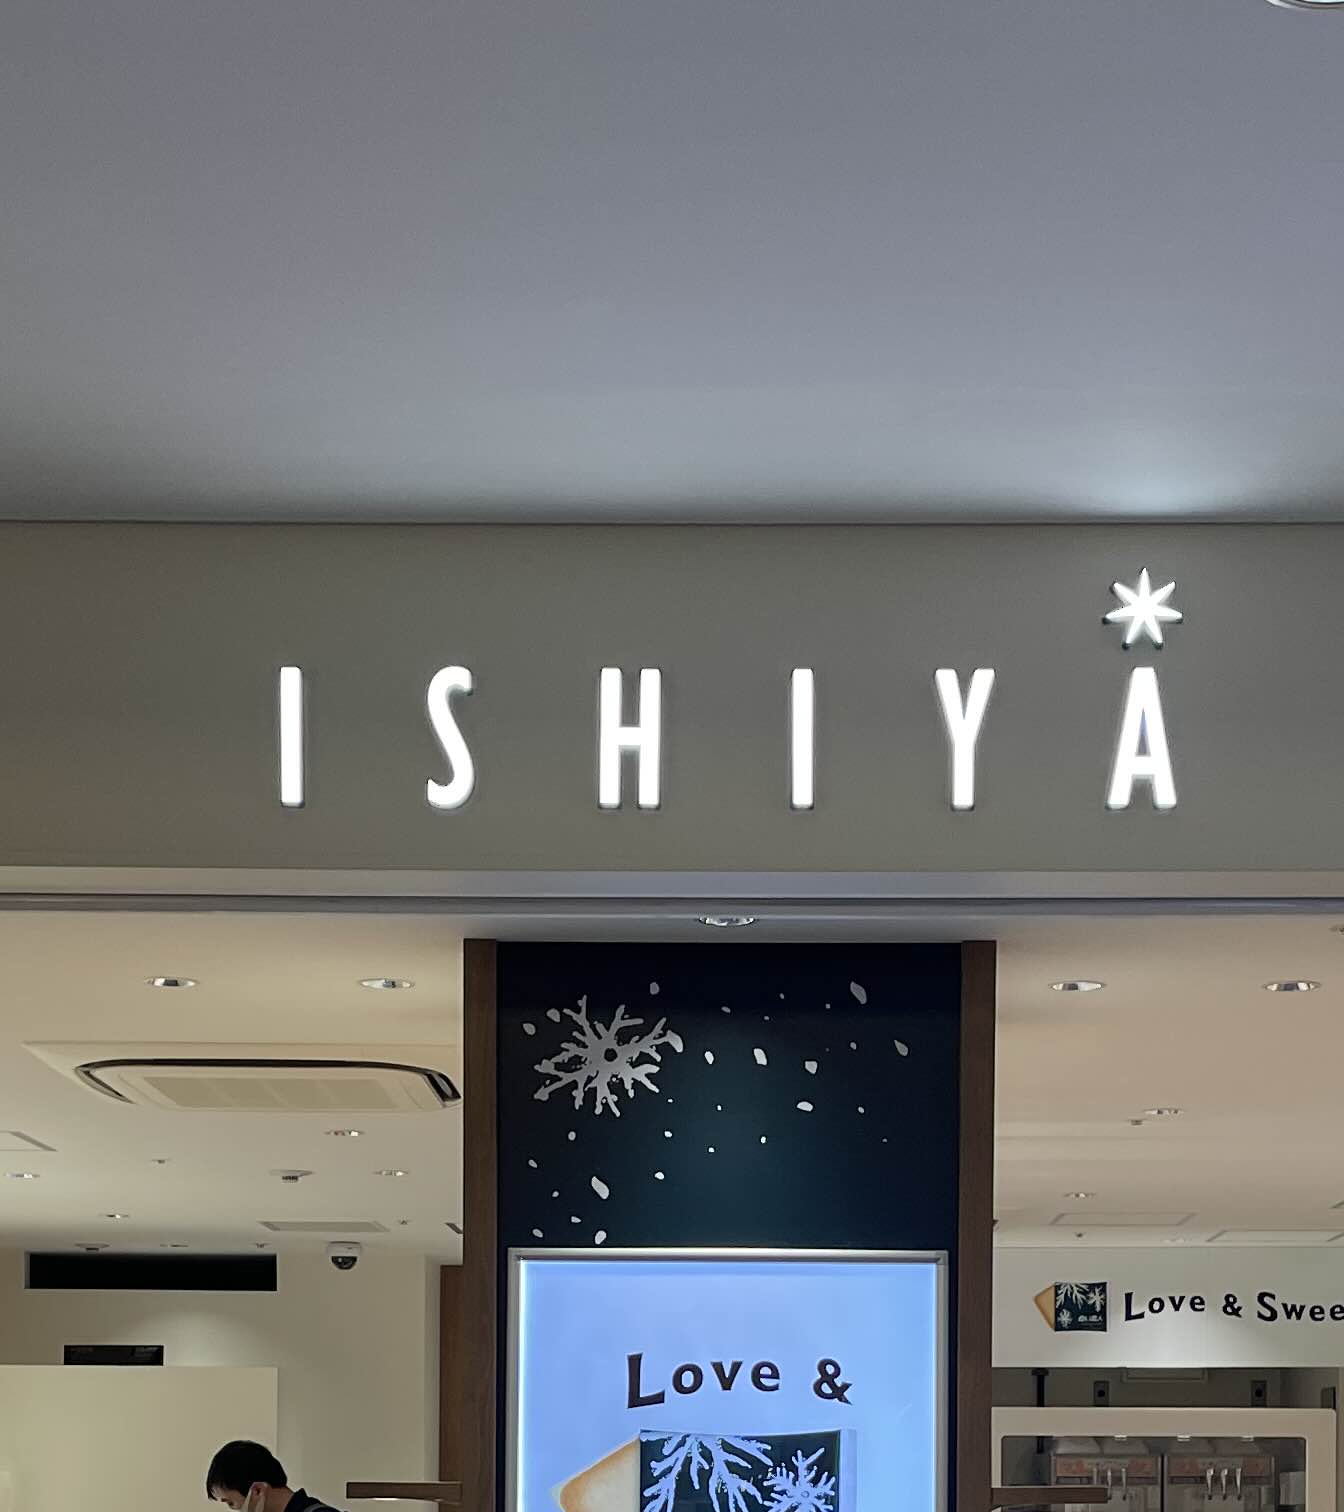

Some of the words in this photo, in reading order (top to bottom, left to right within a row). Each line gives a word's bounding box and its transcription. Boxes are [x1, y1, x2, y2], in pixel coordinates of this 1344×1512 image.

[278, 665, 1178, 810] ISHIYA
[1125, 1291, 1205, 1321] Love
[1222, 1293, 1242, 1318] &
[627, 1352, 780, 1409] Love
[813, 1357, 854, 1406] &
